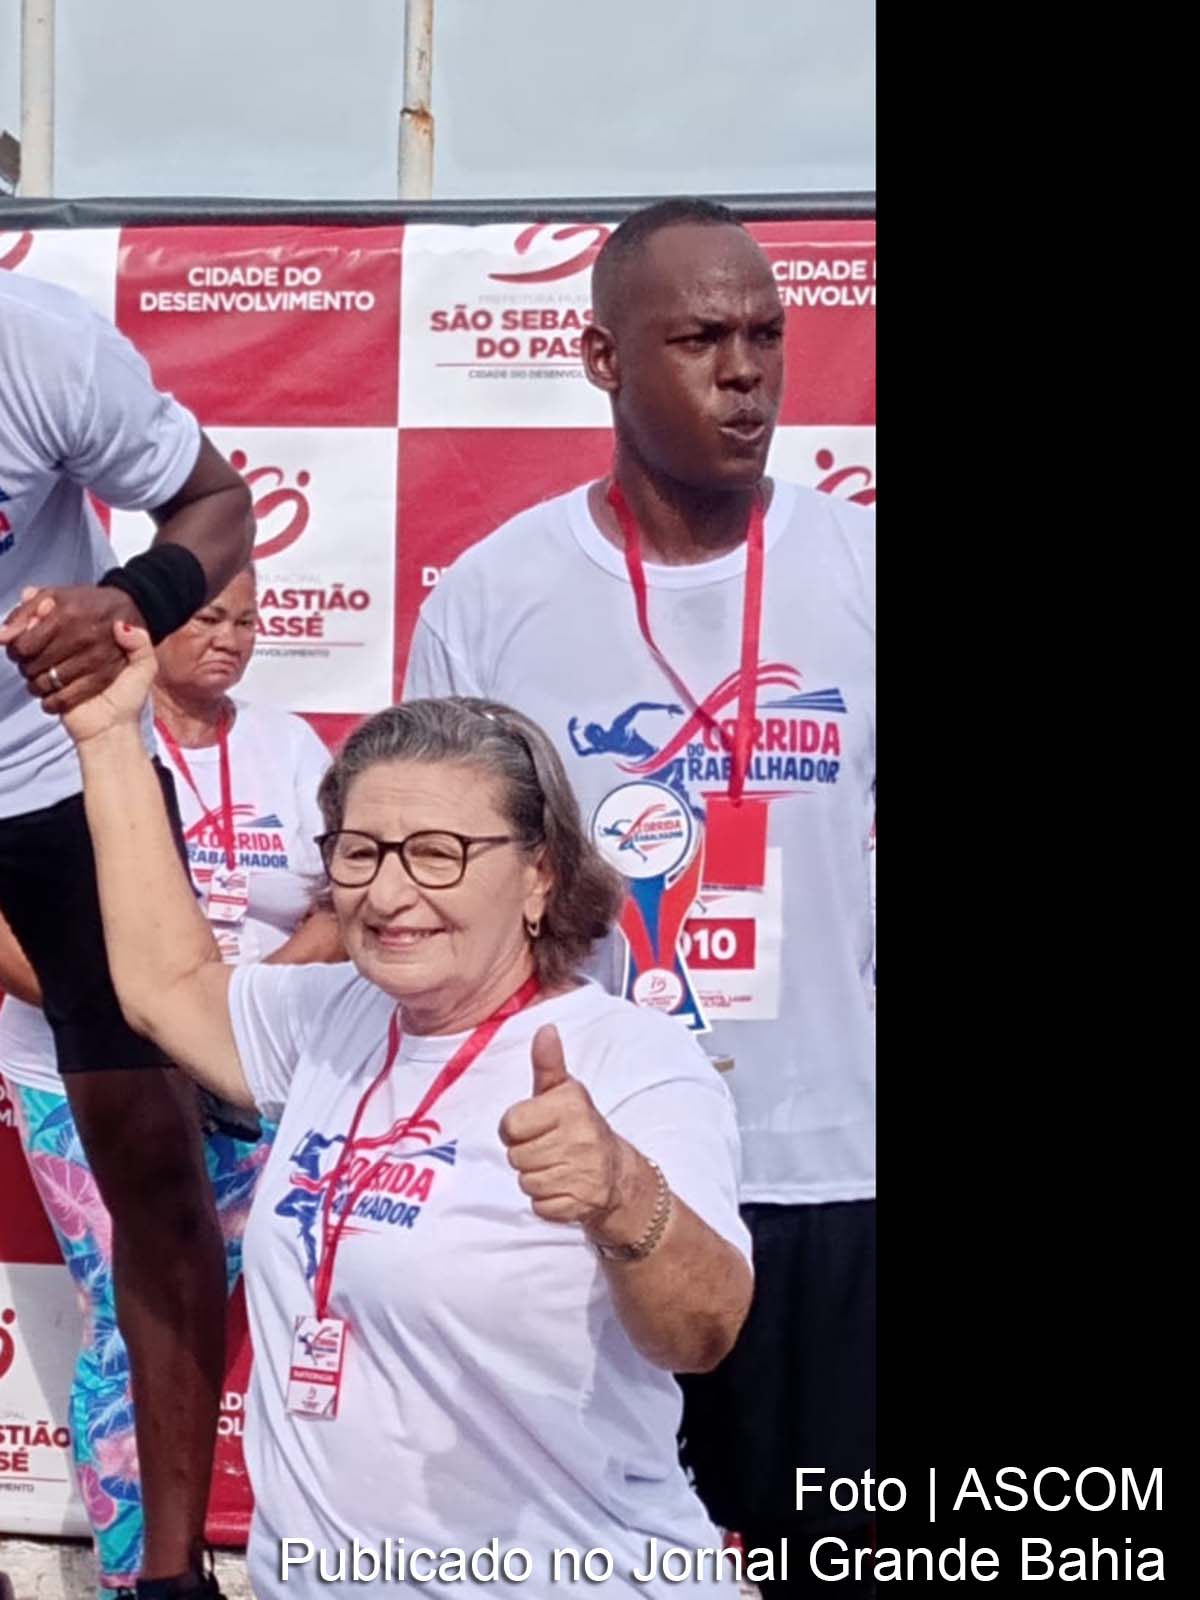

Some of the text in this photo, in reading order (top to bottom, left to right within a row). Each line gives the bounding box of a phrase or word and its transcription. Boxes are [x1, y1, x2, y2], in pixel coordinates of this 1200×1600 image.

[188, 267, 322, 287] CIDADE DO
[771, 260, 867, 281] CIDADE
[140, 290, 375, 312] DESENVOLVIMENTO
[430, 304, 493, 332] SÃO
[476, 337, 520, 358] DO
[197, 832, 285, 852] CORIDA
